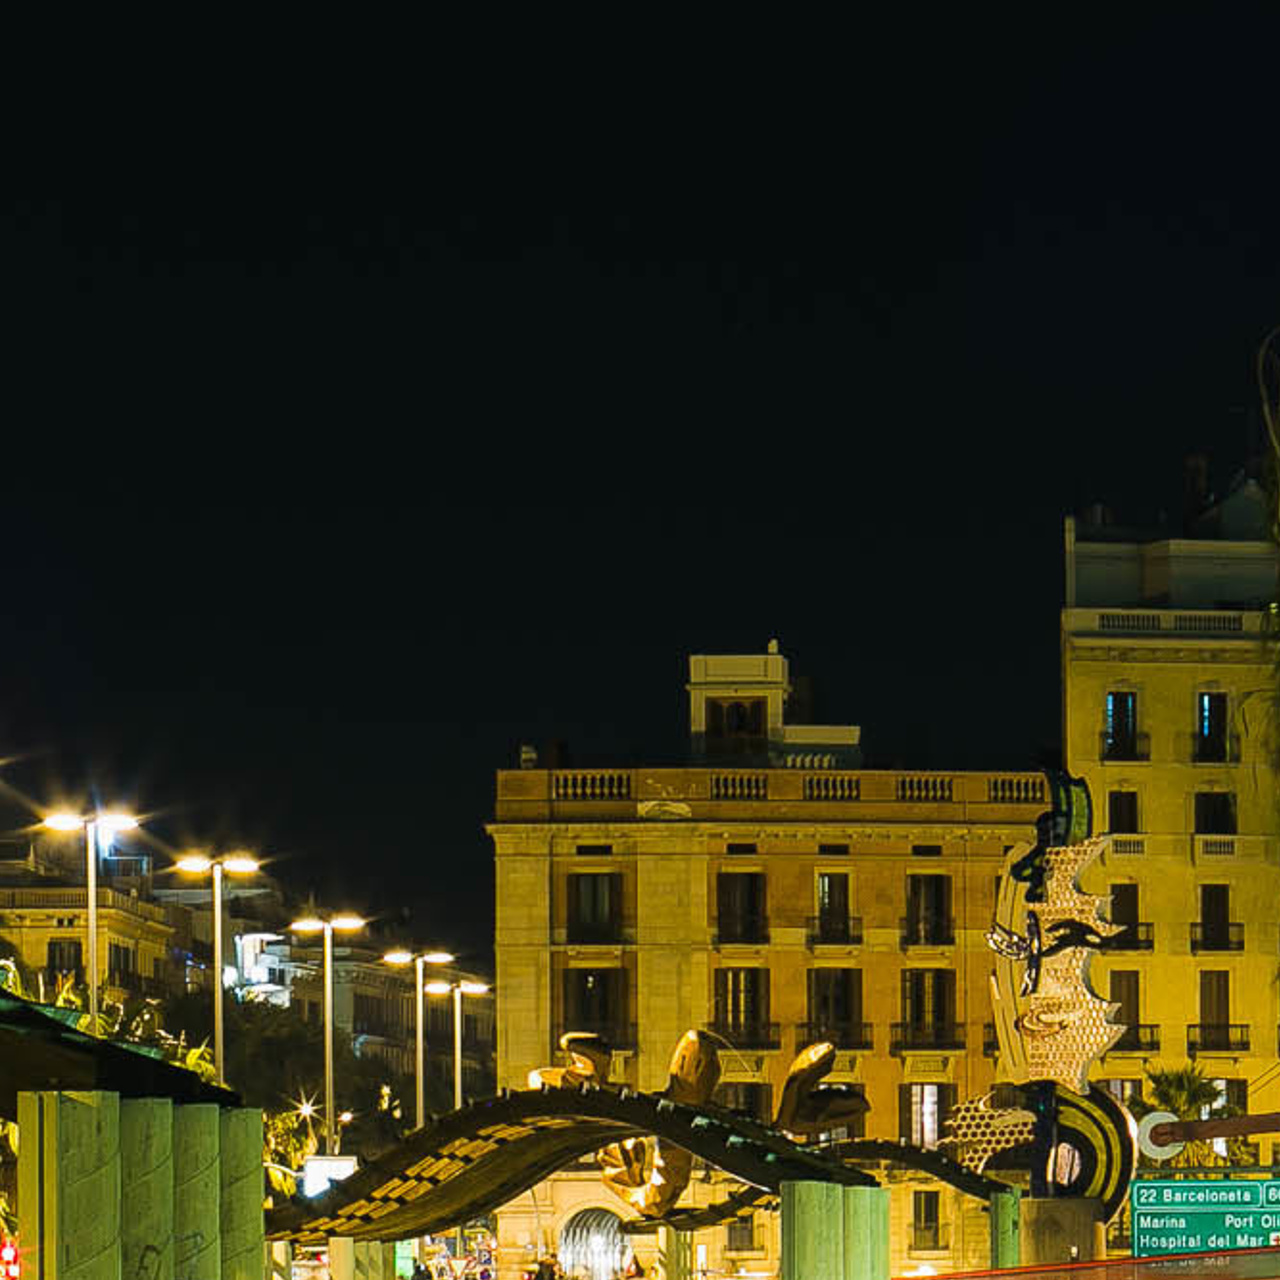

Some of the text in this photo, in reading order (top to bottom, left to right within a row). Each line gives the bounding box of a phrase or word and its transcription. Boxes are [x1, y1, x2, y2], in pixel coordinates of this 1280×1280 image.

[1140, 1189, 1251, 1203] 22 Barceloneta
[1268, 1187, 1280, 1202] 6
[1140, 1215, 1186, 1228] Marina
[1225, 1214, 1253, 1228] Port
[1140, 1234, 1264, 1249] Hospital del Mar
